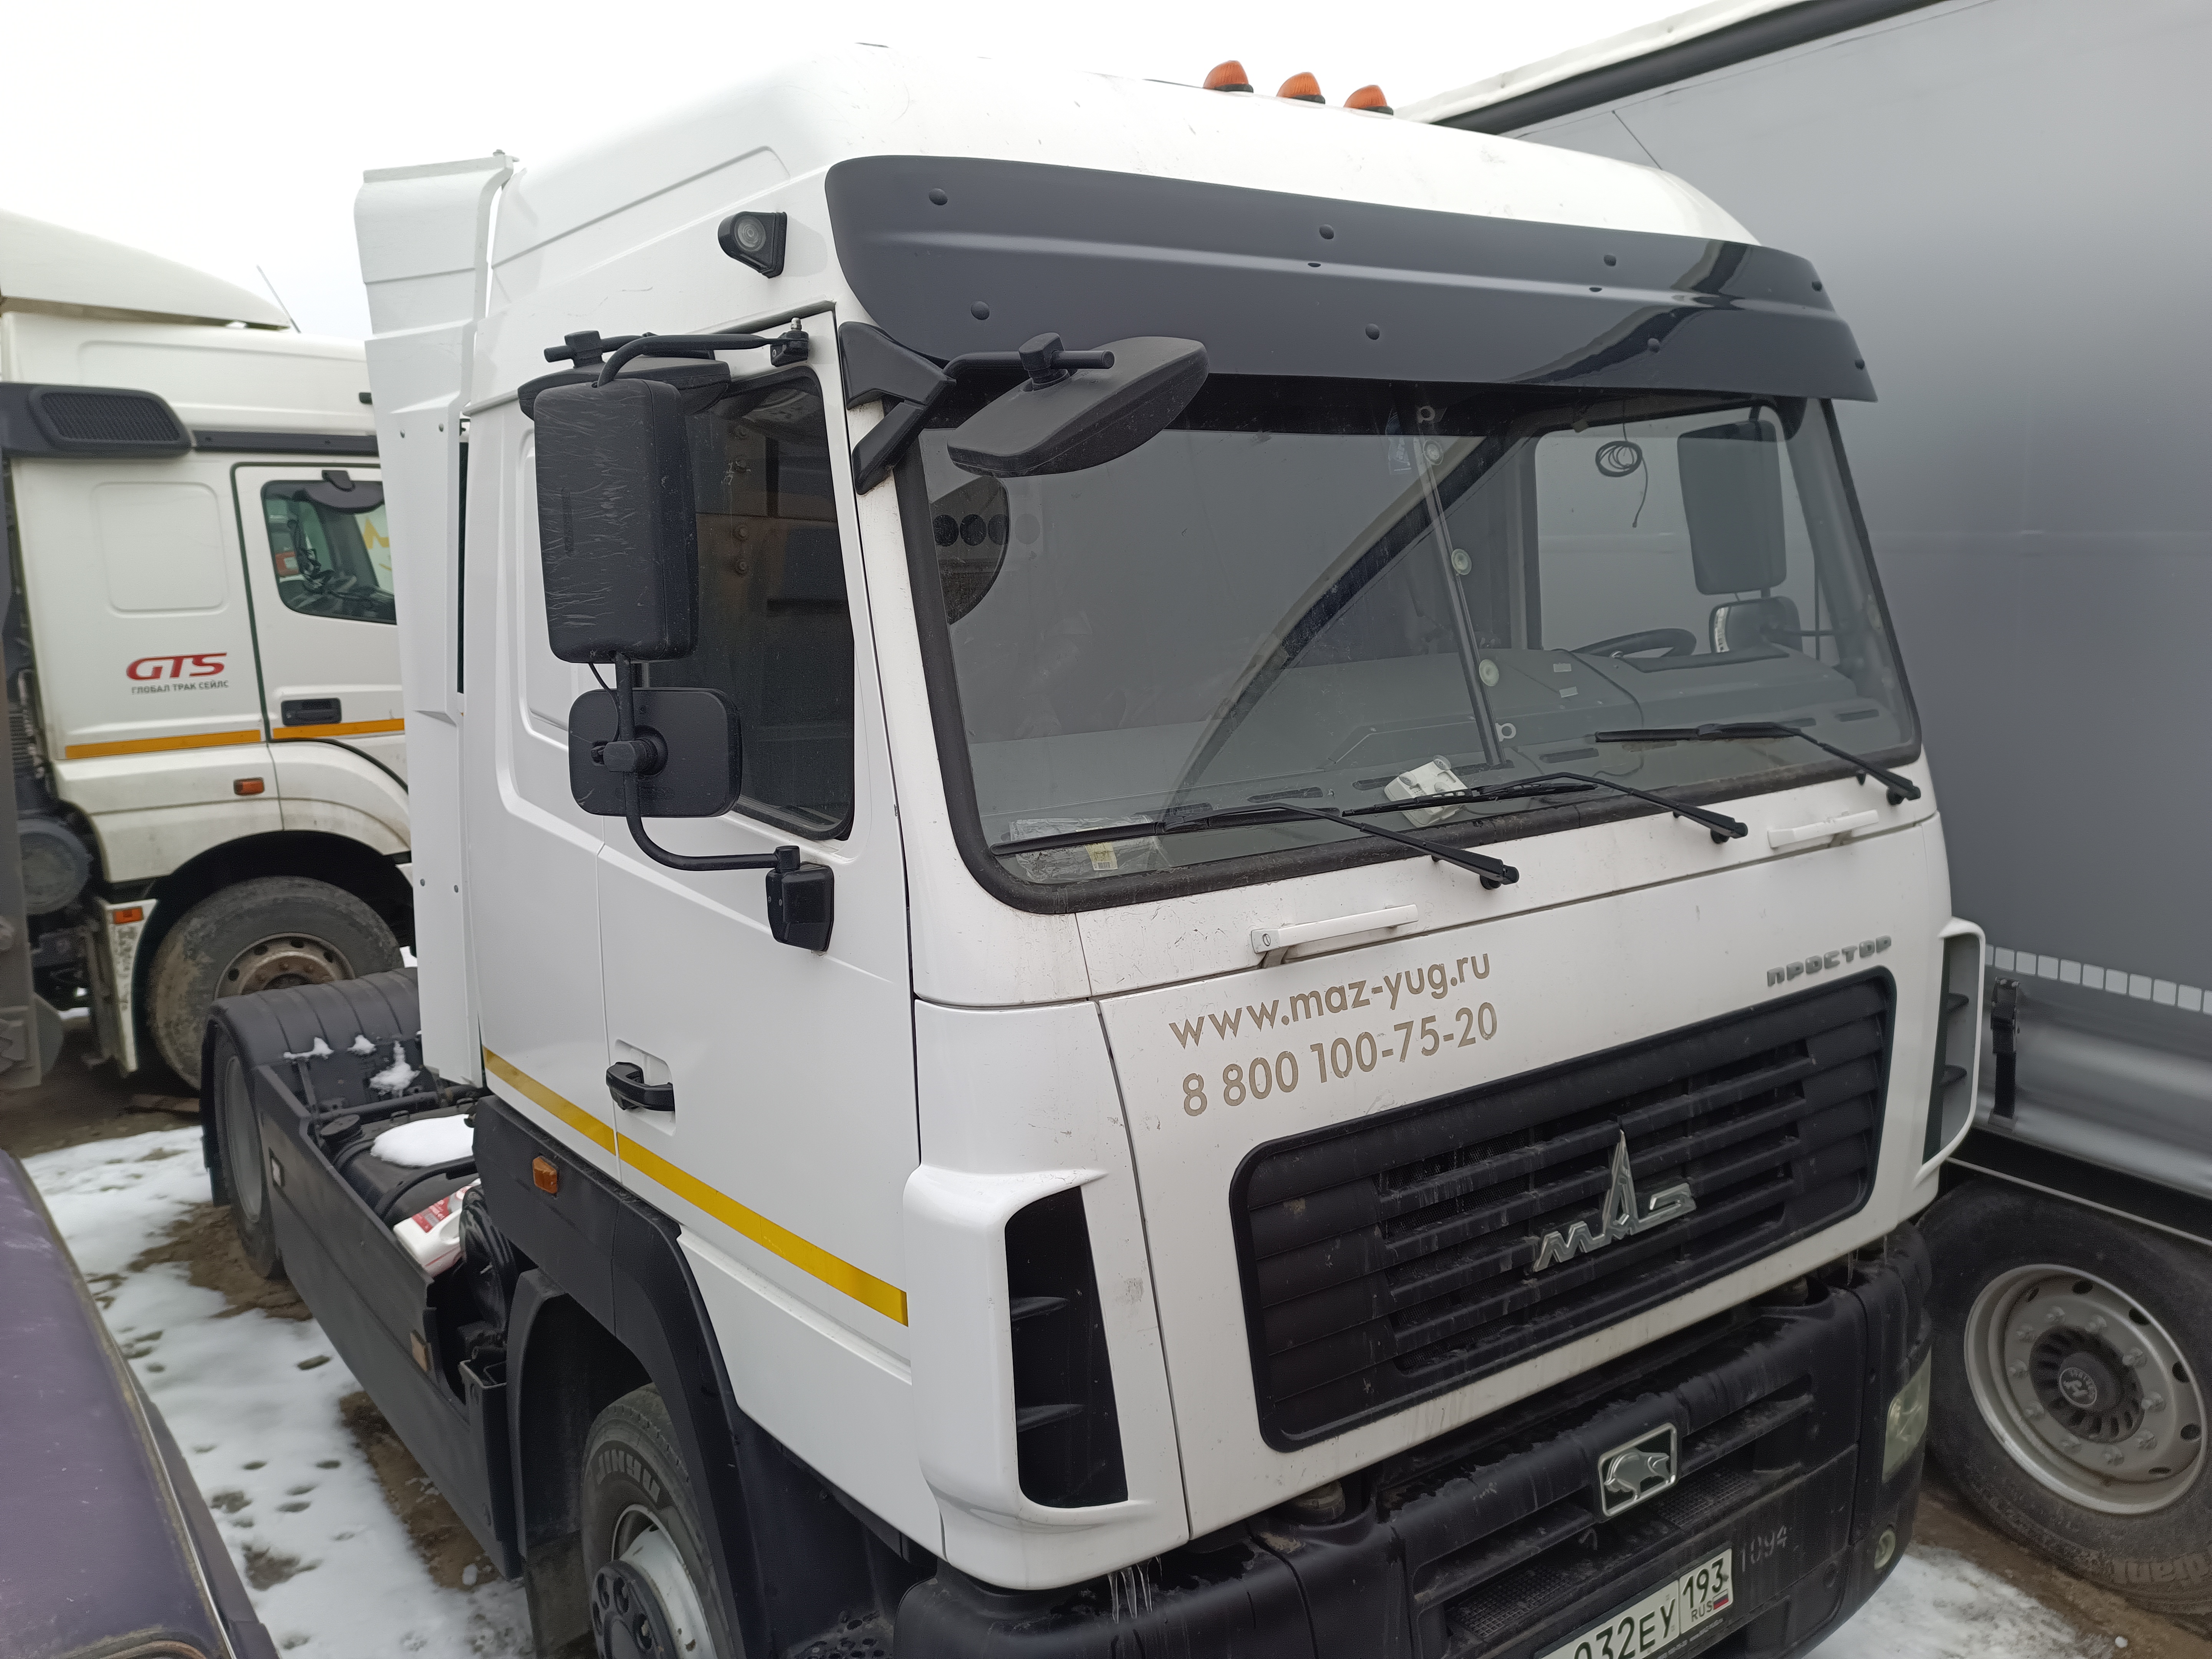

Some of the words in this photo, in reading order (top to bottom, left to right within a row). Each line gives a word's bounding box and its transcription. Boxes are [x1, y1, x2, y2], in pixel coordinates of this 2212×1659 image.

[126, 651, 227, 681] GTS
[131, 684, 170, 695] ГЛОБАЛ
[172, 683, 196, 691] ТРАК
[198, 679, 229, 690] СЕЙЛС
[1767, 935, 1892, 987] ПРОСТОР
[1168, 953, 1490, 1050] www.maz-yug.ru
[1182, 1072, 1207, 1117] 8
[1222, 1051, 1299, 1106] 800
[1310, 1002, 1498, 1083] 100-75-20
[1682, 1558, 1725, 1609] 193
[1691, 1600, 1713, 1623] RUS
